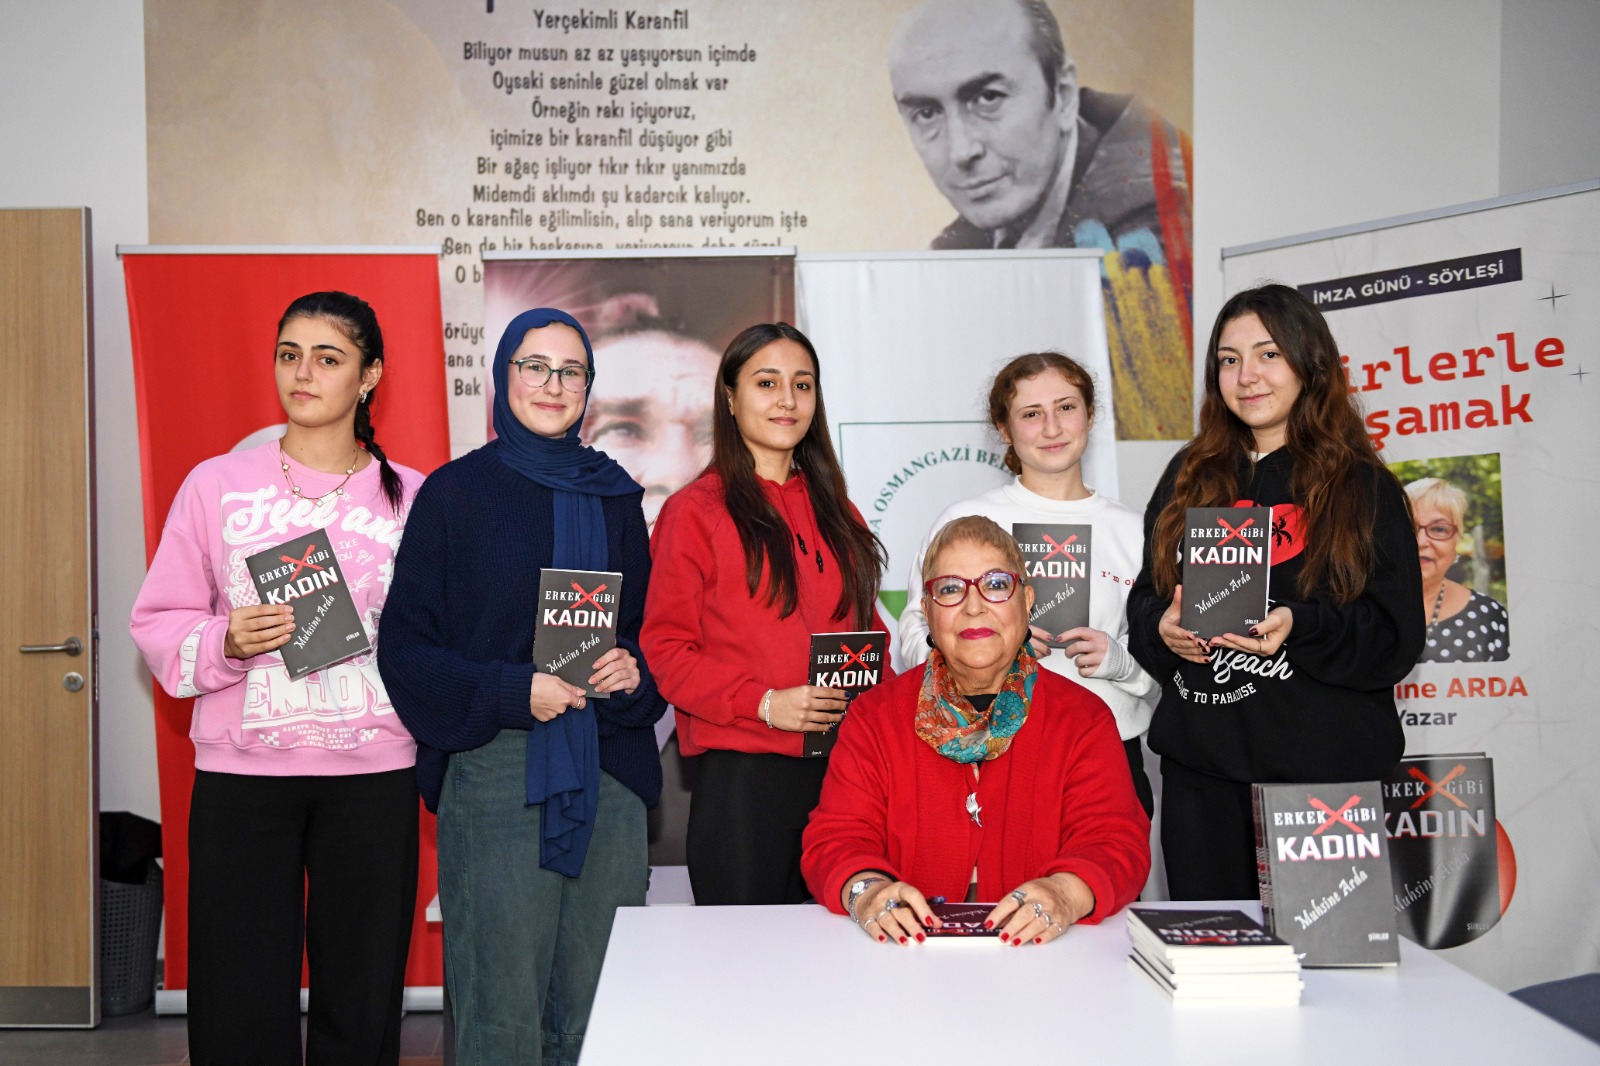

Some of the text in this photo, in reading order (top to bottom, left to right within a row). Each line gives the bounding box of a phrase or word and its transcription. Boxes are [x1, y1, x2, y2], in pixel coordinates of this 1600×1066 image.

[534, 9, 688, 34] Yerçekimli Karanfil
[464, 41, 756, 66] Biliyor musun az az yaşıyorsun içimde
[493, 70, 728, 96] Oysaki seninle güzel olmak var
[532, 97, 695, 124] Örneğin rakı içiyoruz,
[491, 128, 731, 153] içimize bir karanfil düşüyor gibi
[477, 156, 745, 179] Bir ağaç işliyor tıkır tıkır yanımızda
[473, 184, 750, 208] Midemdi aklımdı şu kadarcık kalıyor.
[416, 208, 807, 234] Sen o karanfile eğilimlisin, alıp sana veriyorum işte
[444, 237, 472, 255] Sen
[1313, 287, 1356, 305] İMZA
[1361, 276, 1411, 298] GÜNÜ
[1428, 260, 1504, 286] SÖYLEŞİ
[1341, 332, 1565, 395] irlerle
[454, 377, 481, 396] Bak
[1365, 384, 1533, 451] şamak
[874, 444, 970, 512] OSMANGAZİ
[1190, 528, 1228, 538] ERKEK
[1189, 546, 1263, 564] KADIN
[259, 562, 296, 584] ERKEK
[266, 566, 339, 605] KADIN
[545, 590, 581, 601] ERKEK
[1055, 583, 1075, 604] Arda
[1195, 570, 1251, 614] Muhsine Arda
[294, 616, 321, 649] Muhsine
[317, 594, 335, 616] Arda
[543, 608, 613, 628] KADIN
[546, 633, 600, 673] Muhsine Arda
[817, 653, 849, 665] ERKEK
[815, 669, 878, 688] KADIN
[1447, 676, 1529, 699] ARDA
[1193, 691, 1207, 704] TO
[1212, 682, 1257, 704] PARADISE
[1273, 810, 1327, 826] ERKEK
[1277, 833, 1381, 862] KADIN
[1294, 866, 1368, 930] Muhsine Arda
